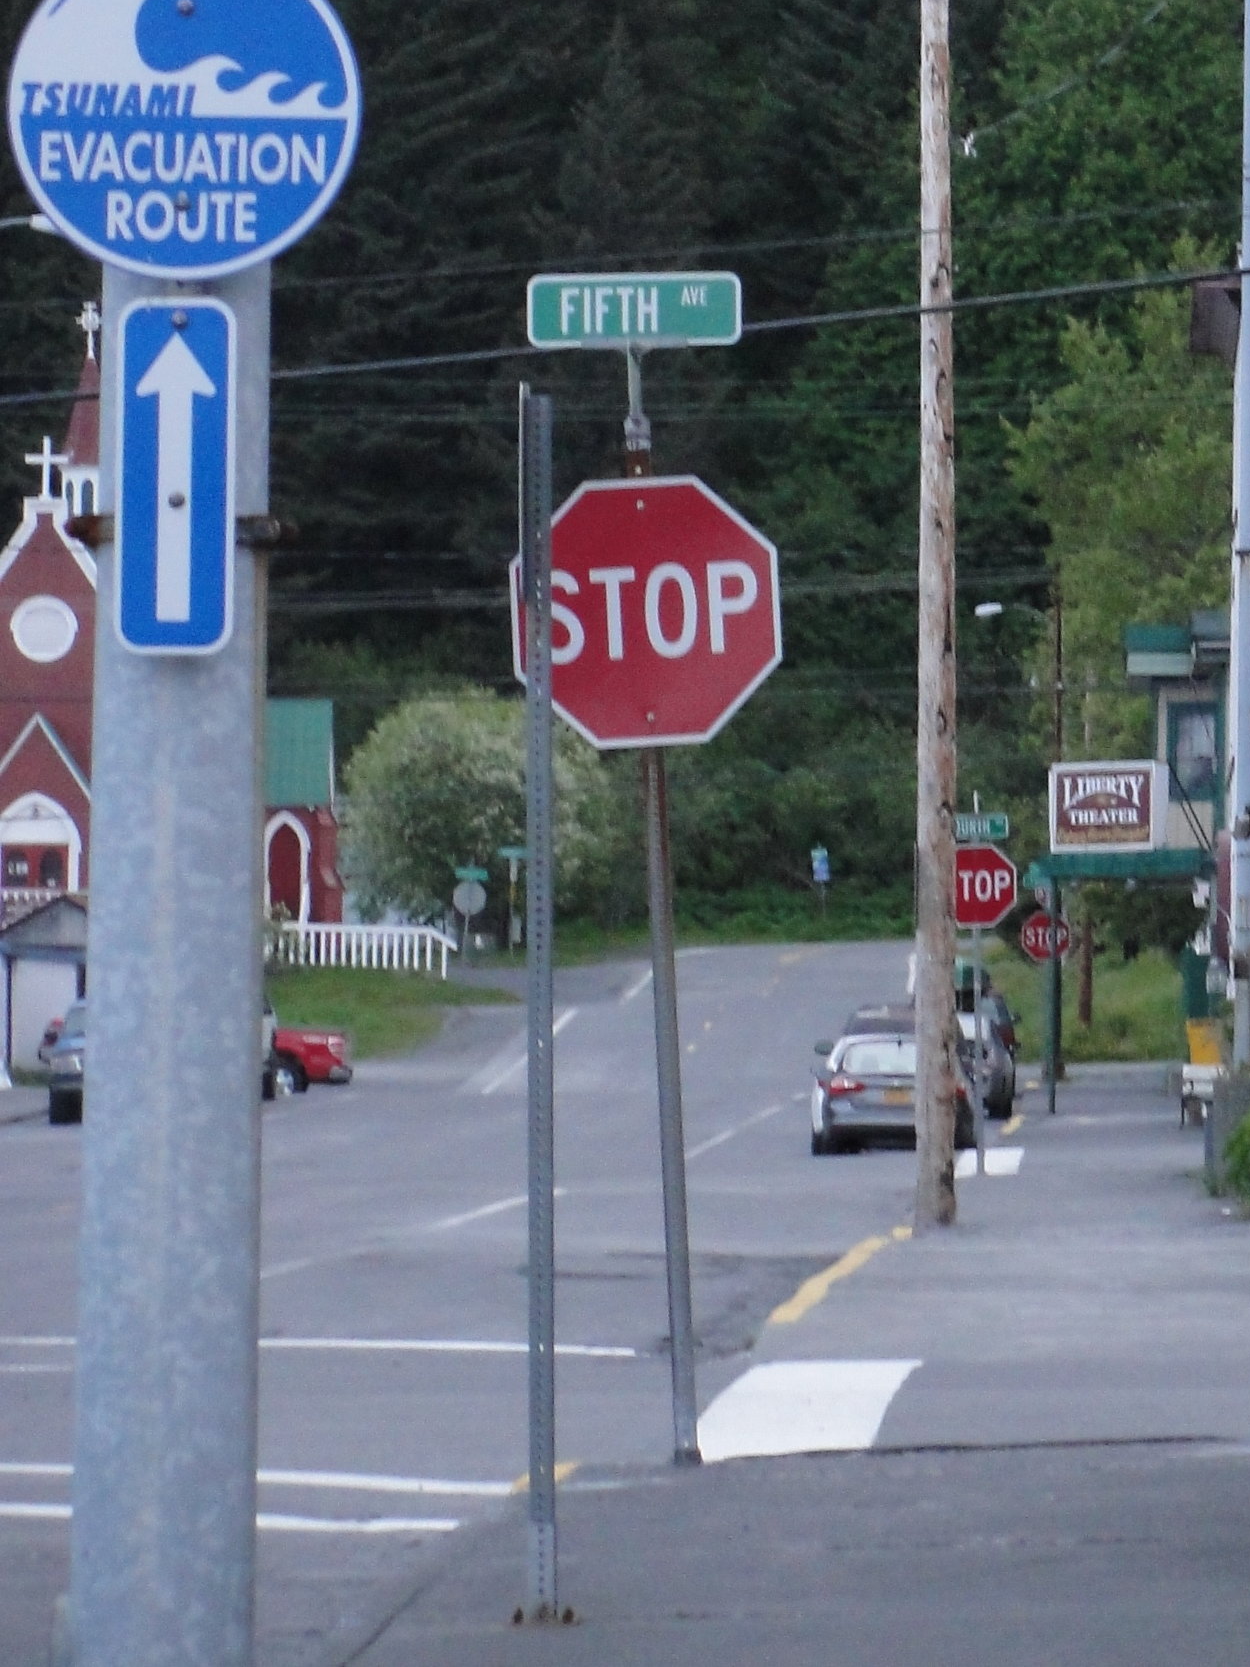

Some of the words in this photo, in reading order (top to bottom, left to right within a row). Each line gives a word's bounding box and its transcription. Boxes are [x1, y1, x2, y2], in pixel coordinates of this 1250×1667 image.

[21, 82, 197, 118] TSUNAMI
[39, 131, 327, 184] EVACUATION
[105, 189, 258, 243] ROUTE
[560, 285, 659, 335] FIFTH
[681, 285, 708, 307] AVE
[550, 560, 758, 666] STOP
[1063, 774, 1144, 811] LIBERTY
[1067, 807, 1139, 826] THEATER
[958, 869, 1011, 903] TOP
